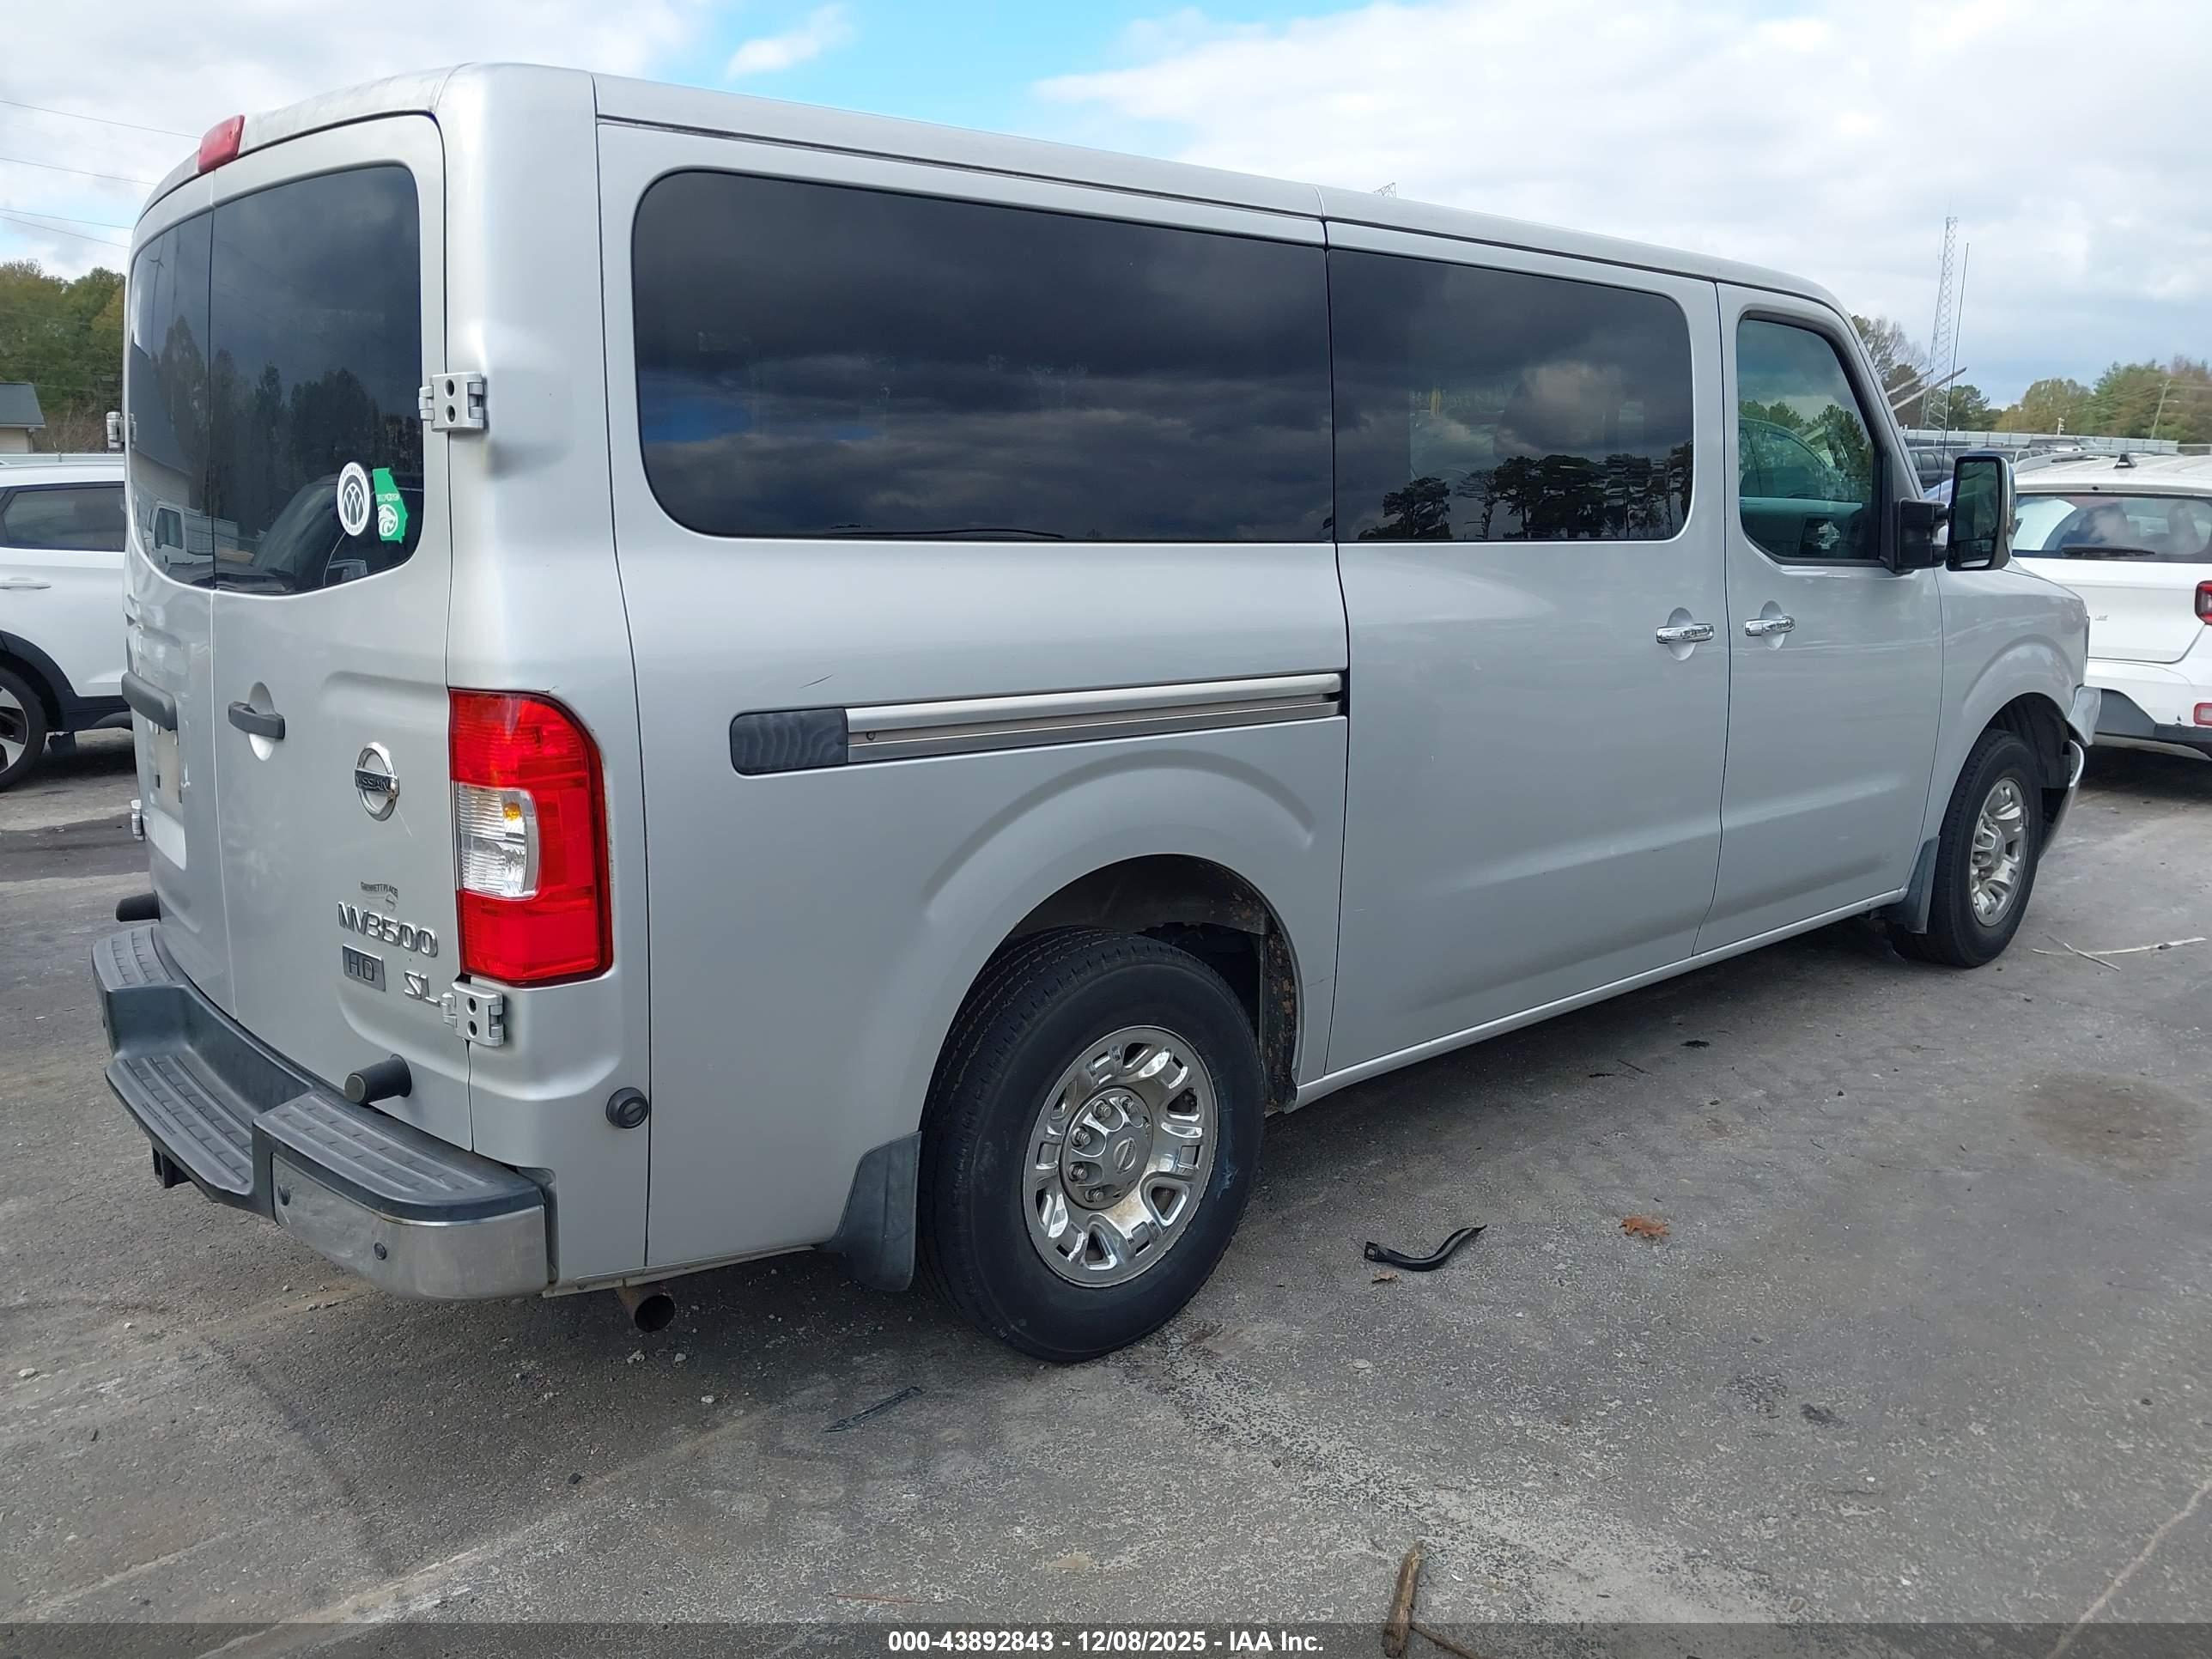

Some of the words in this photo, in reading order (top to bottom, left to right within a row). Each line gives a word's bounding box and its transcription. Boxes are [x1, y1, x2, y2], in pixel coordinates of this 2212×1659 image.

[355, 775, 391, 792] NISSAN
[337, 901, 438, 958] NV3500
[348, 951, 375, 982] HD
[403, 969, 441, 1008] SL
